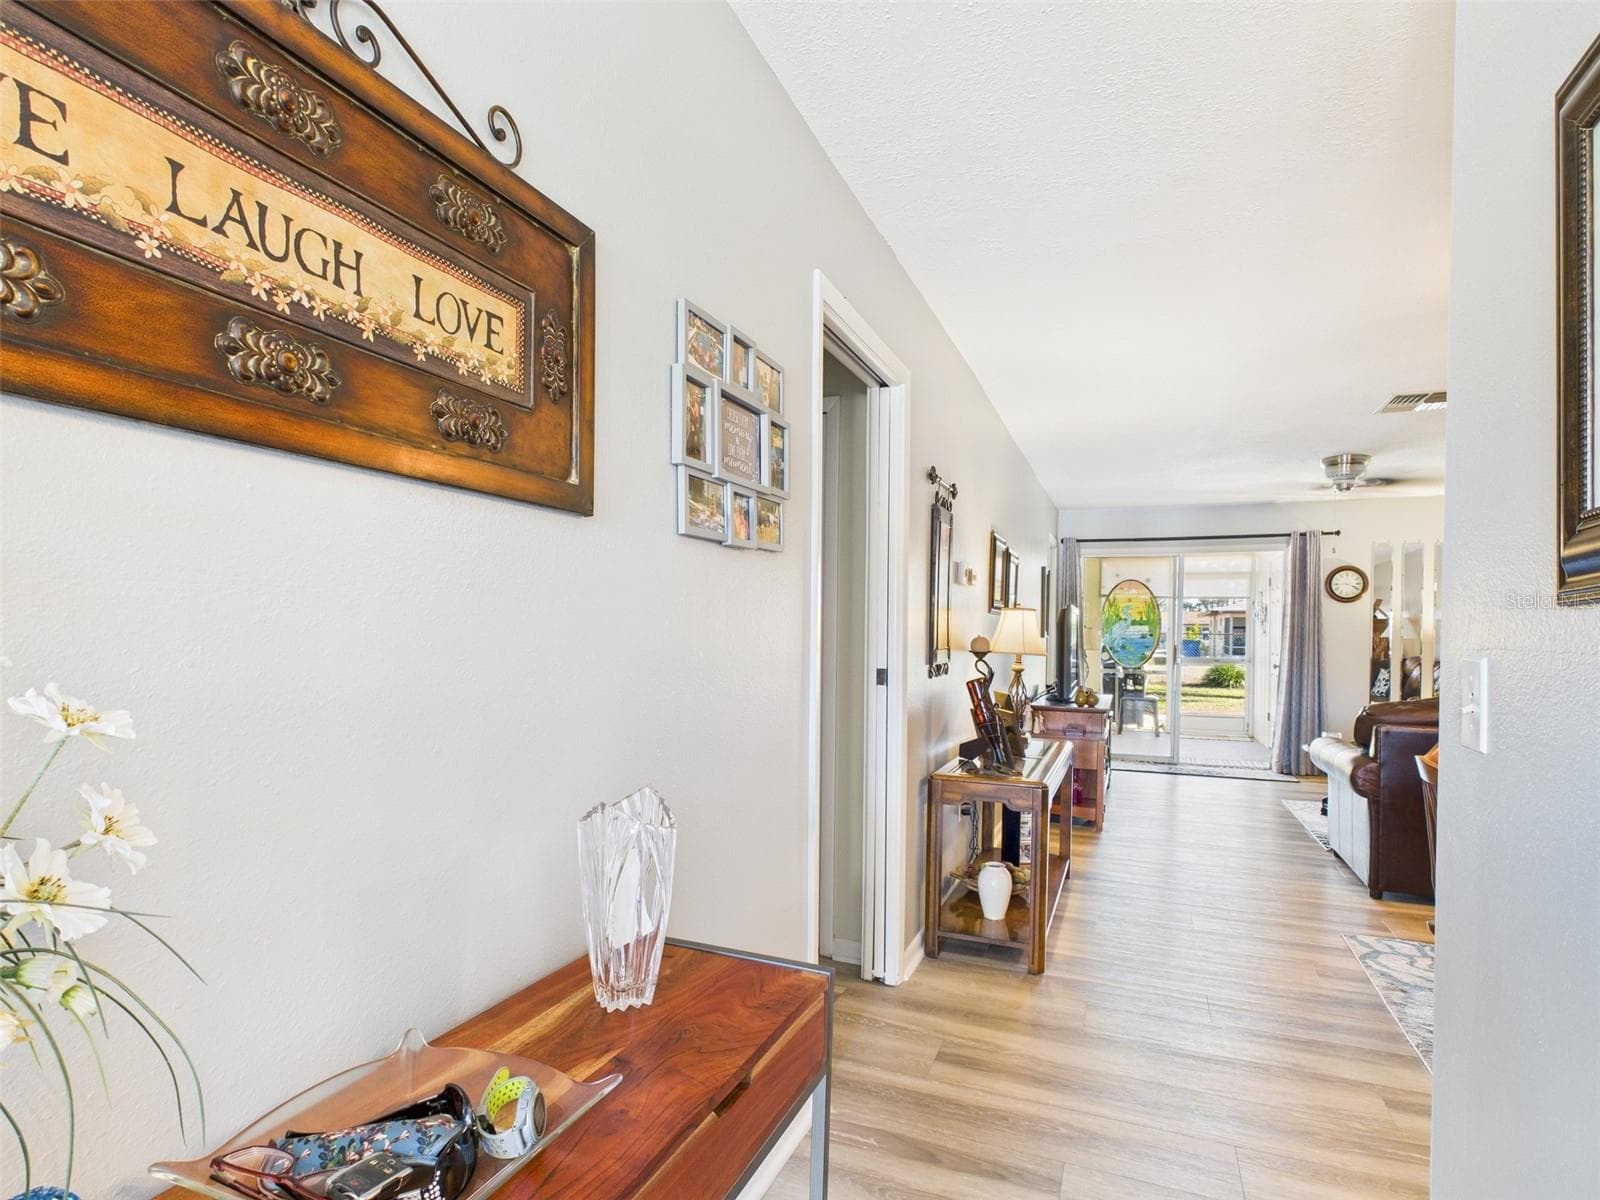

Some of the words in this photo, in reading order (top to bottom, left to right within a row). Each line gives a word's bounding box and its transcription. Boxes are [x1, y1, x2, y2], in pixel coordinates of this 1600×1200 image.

[0, 72, 70, 166] E
[165, 157, 363, 297] LAUGH
[412, 274, 504, 355] LOVE
